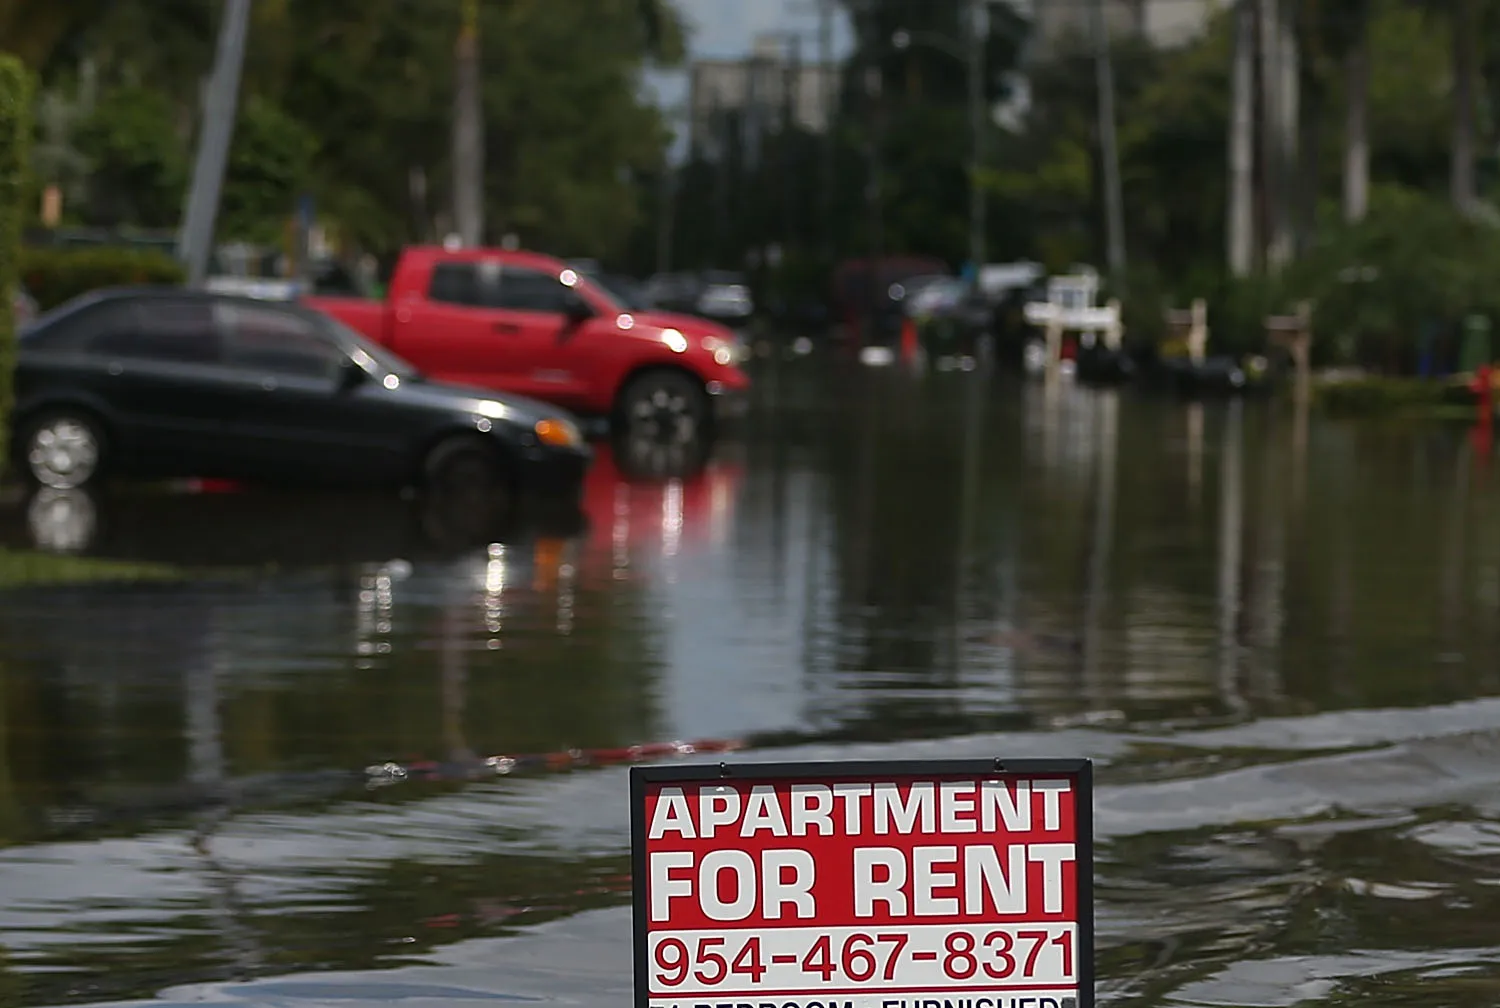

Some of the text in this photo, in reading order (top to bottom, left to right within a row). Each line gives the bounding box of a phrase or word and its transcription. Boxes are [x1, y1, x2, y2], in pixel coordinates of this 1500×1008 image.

[648, 780, 1071, 839] APARTMENT
[650, 843, 1075, 922] FOR RENT
[654, 930, 1073, 986] 954-467-8371
